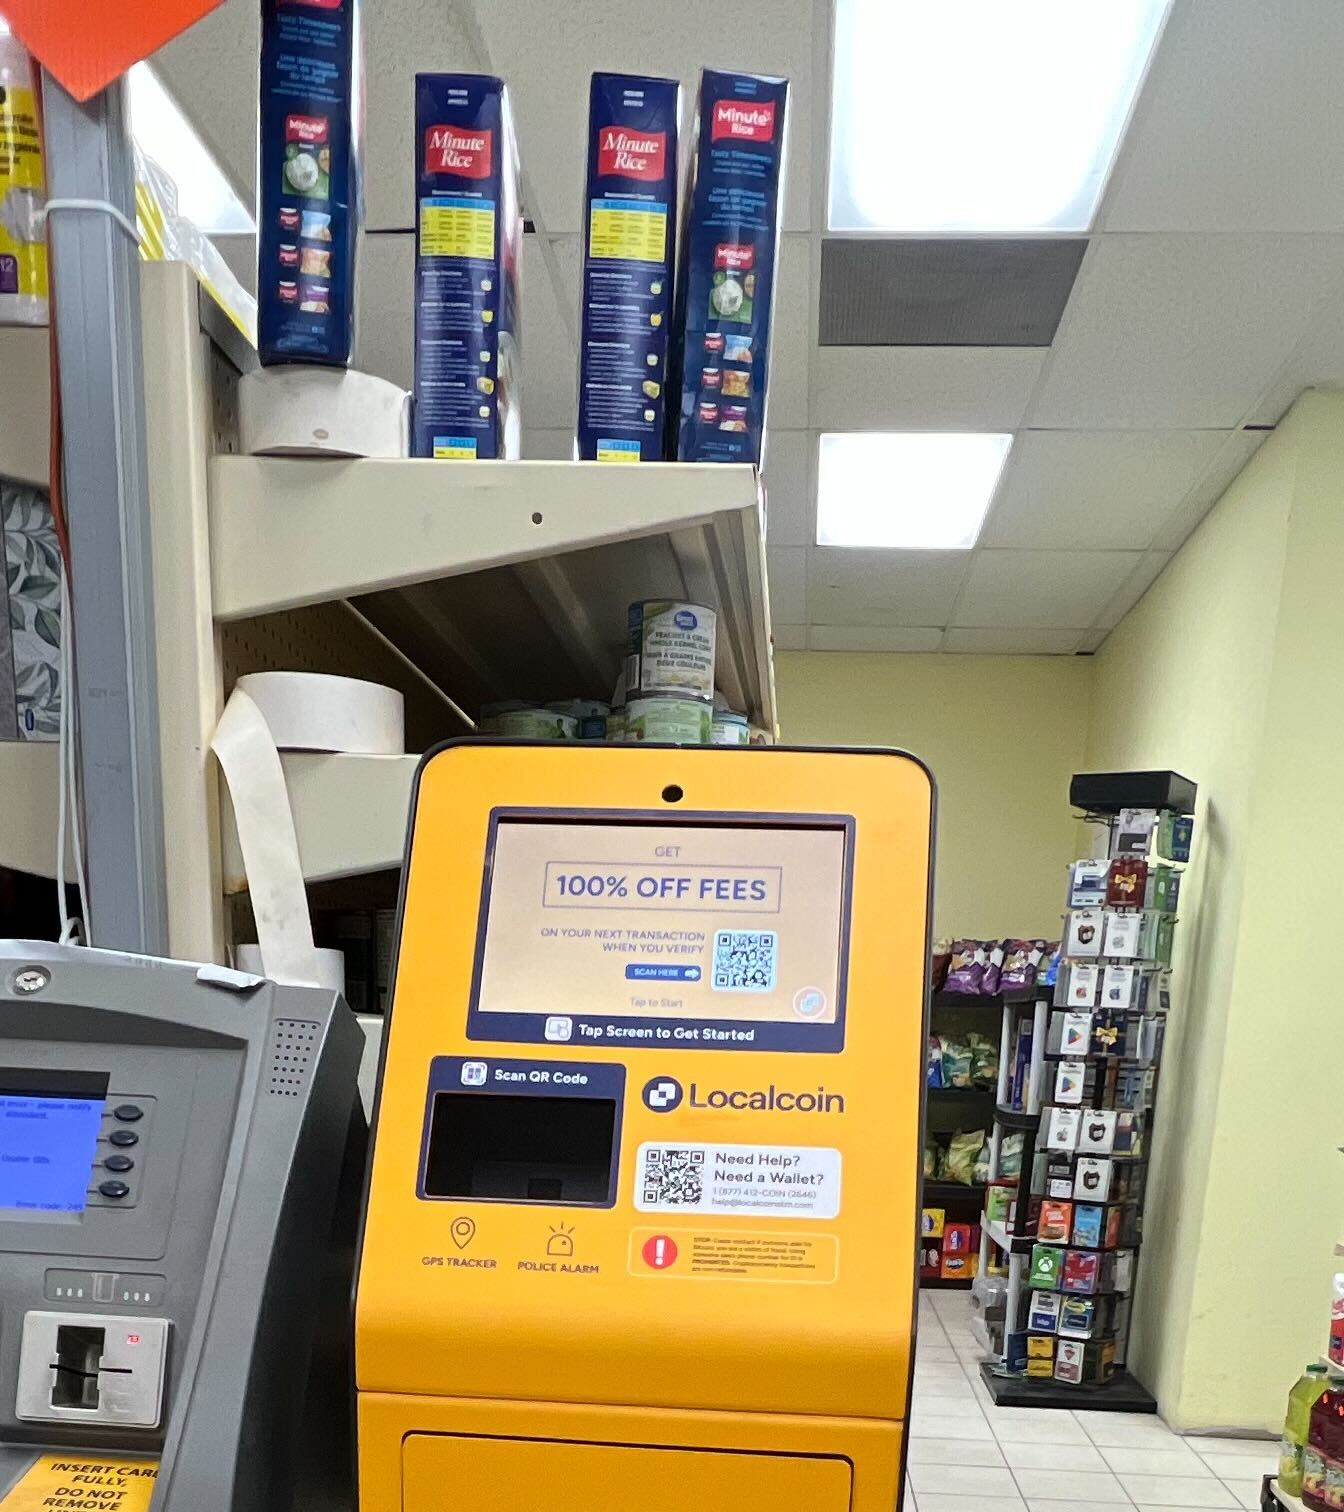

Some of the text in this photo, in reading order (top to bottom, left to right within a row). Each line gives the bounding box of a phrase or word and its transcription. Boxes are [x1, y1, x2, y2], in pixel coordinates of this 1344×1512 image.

[717, 107, 769, 127] Minute
[730, 123, 755, 136] Rice
[429, 130, 485, 151] Minute
[602, 132, 659, 154] Minute
[440, 150, 473, 168] Rice
[613, 152, 647, 170] Rice
[654, 846, 682, 857] GET
[556, 874, 767, 901] 100% OFF FEES
[540, 927, 706, 942] ON YOUR NEXT TRANSACTION
[602, 942, 705, 955] WHEN YOU VERIFY
[578, 1024, 756, 1043] Tap Screen to Get Started
[494, 1068, 589, 1087] Scan QR Code
[689, 1083, 846, 1115] Localcoin
[715, 1152, 801, 1168] Need Help?
[714, 1170, 824, 1186] Need a Wallet?
[422, 1256, 498, 1270] GPS TRACKER
[517, 1260, 600, 1275] POLICE ALARM
[50, 1462, 114, 1475] INSERT
[71, 1474, 128, 1488] FULLY,
[54, 1486, 129, 1500] DO NOT
[42, 1497, 123, 1511] REMOVE
